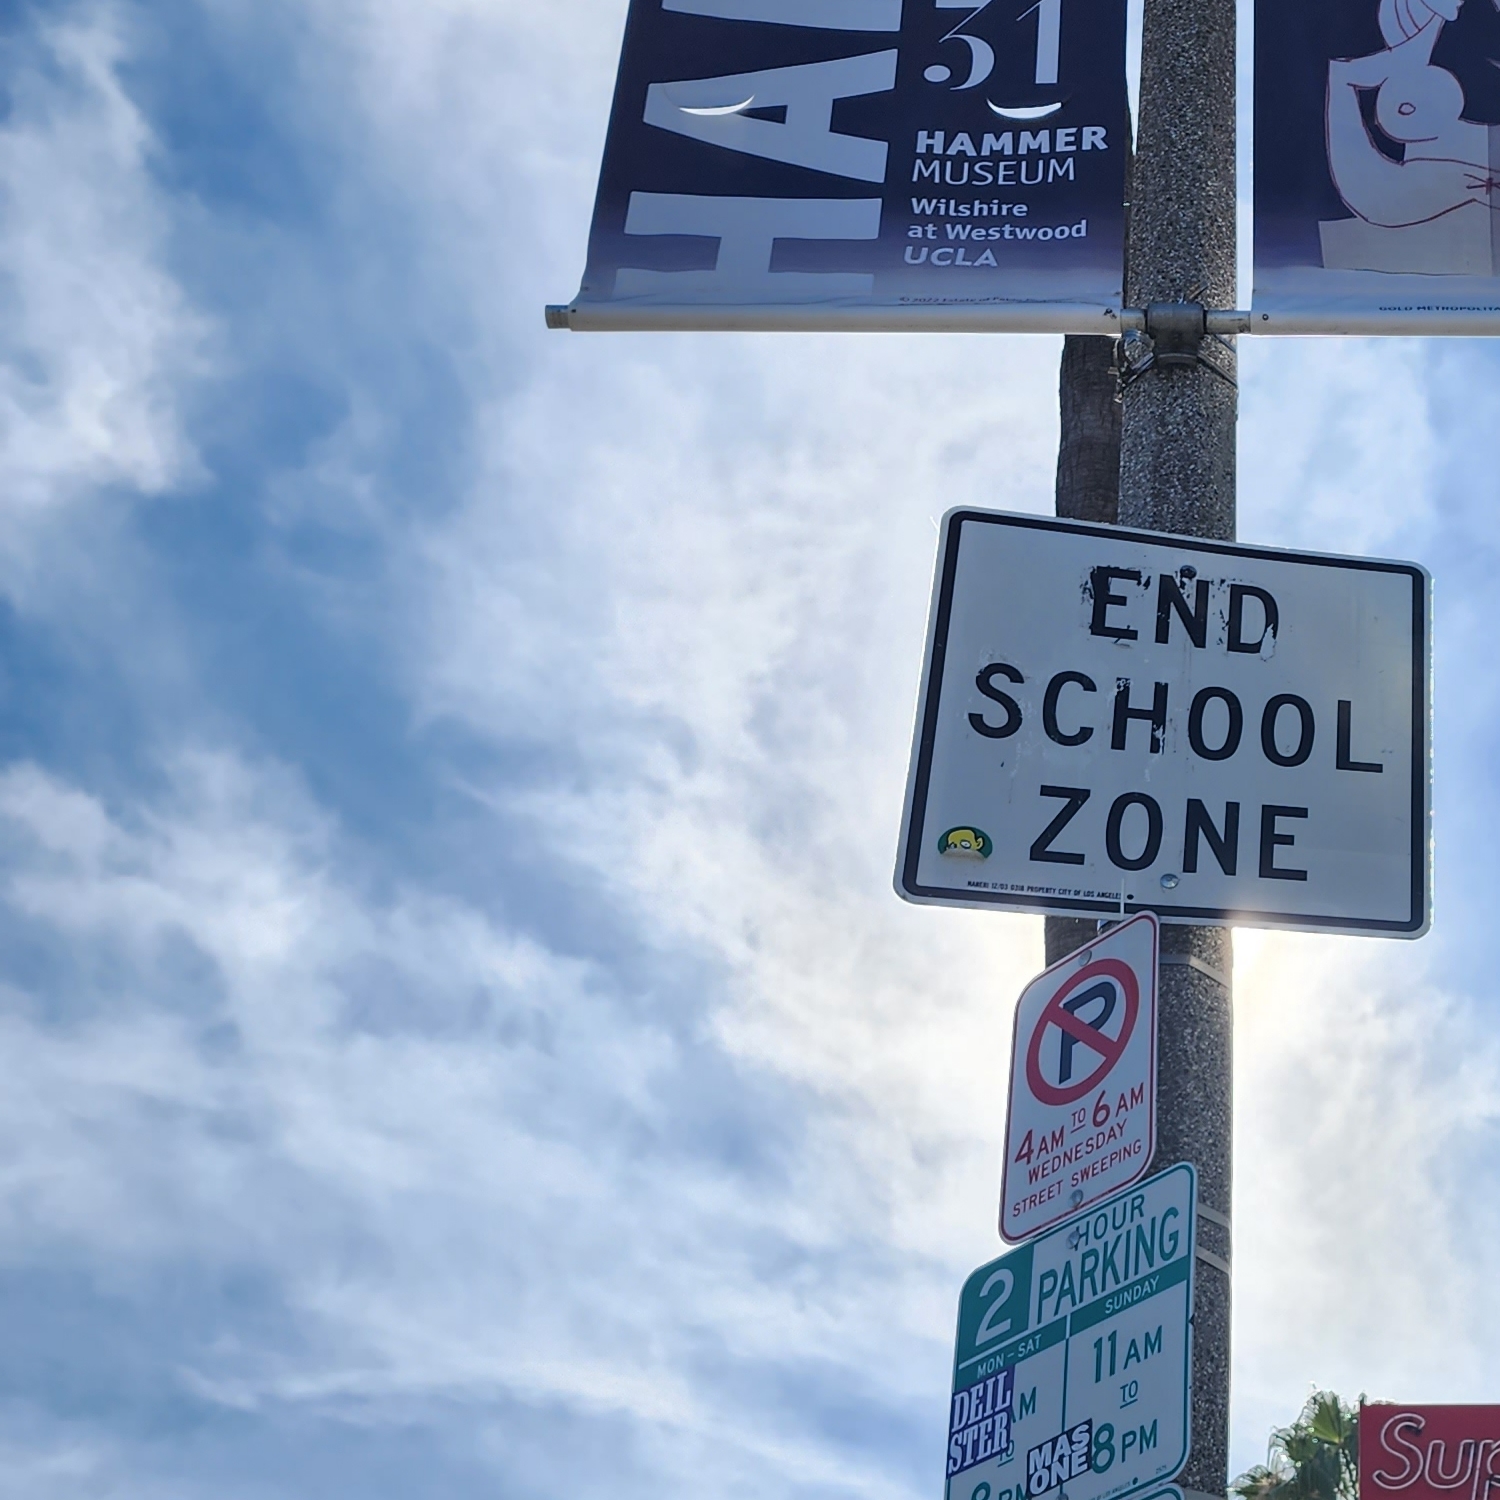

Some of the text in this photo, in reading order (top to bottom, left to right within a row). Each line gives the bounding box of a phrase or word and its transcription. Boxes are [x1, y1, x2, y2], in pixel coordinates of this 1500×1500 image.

[923, 0, 1062, 90] 31
[915, 126, 1109, 157] HAMMER
[911, 157, 1075, 185] MUSEUM
[908, 219, 1088, 241] at Westwood
[911, 198, 1028, 218] Wilshire
[904, 246, 998, 268] UCLA
[1089, 566, 1279, 655] END
[967, 662, 1384, 774] SCHOOL
[1028, 785, 1309, 882] ZONE
[1026, 885, 1056, 895] PROPERTY
[1058, 888, 1072, 896] CITY
[1073, 889, 1081, 897] OF
[1083, 890, 1095, 898] LOS
[1071, 1107, 1086, 1128] TO
[1028, 1118, 1129, 1185] WEDNESDAY
[1012, 1139, 1142, 1218] STREET SWEEPING
[975, 1194, 1145, 1347] 2 HOUR
[1036, 1206, 1180, 1326] PARKING
[1105, 1275, 1160, 1315] SUNDAY
[1120, 1380, 1139, 1404] TO
[948, 1411, 1009, 1475] STER
[1029, 1424, 1090, 1475] MAS
[1030, 1446, 1089, 1496] ONE
